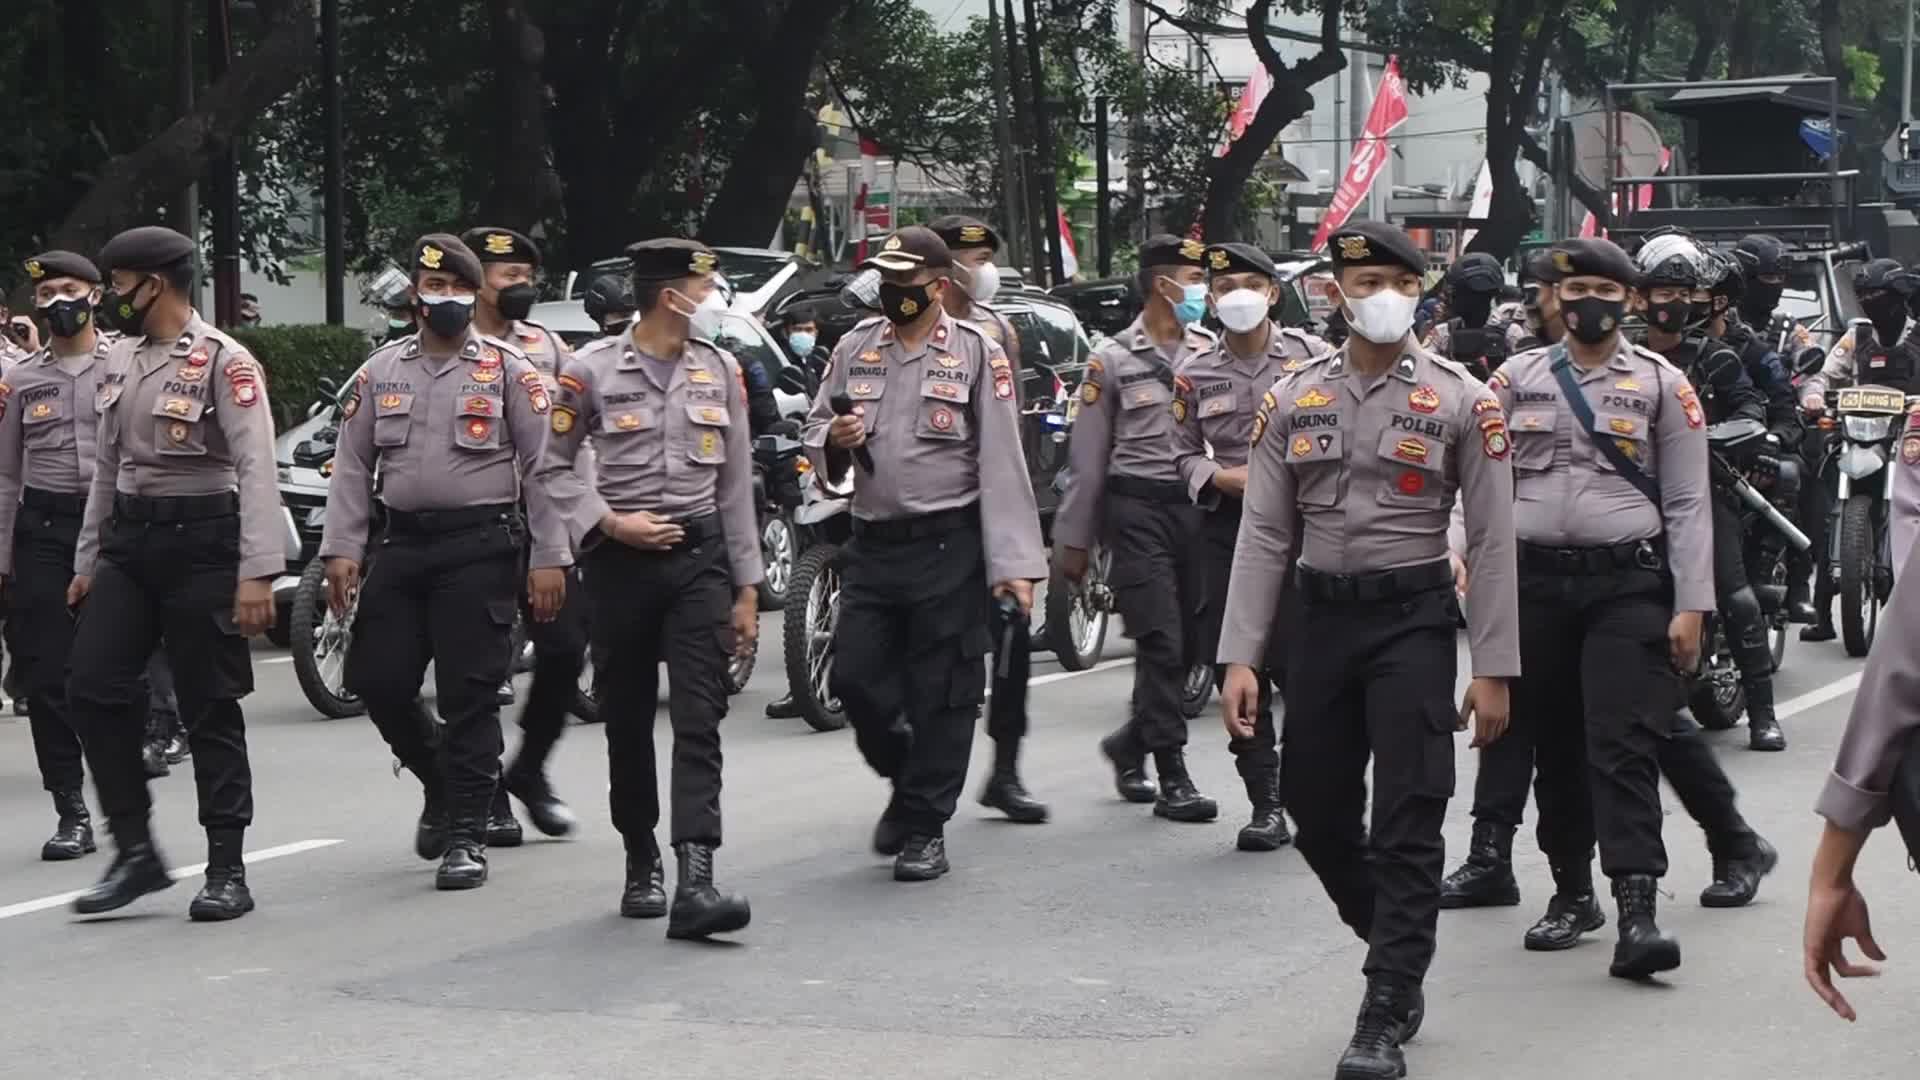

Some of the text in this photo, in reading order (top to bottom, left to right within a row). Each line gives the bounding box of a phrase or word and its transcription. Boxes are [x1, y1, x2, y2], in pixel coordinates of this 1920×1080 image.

[927, 369, 969, 382] POLRI
[163, 381, 205, 400] POLRI
[462, 383, 500, 394] POLRI
[1602, 395, 1647, 410] POLRI
[1290, 414, 1338, 430] AGUNG
[1391, 415, 1443, 437] POLRI
